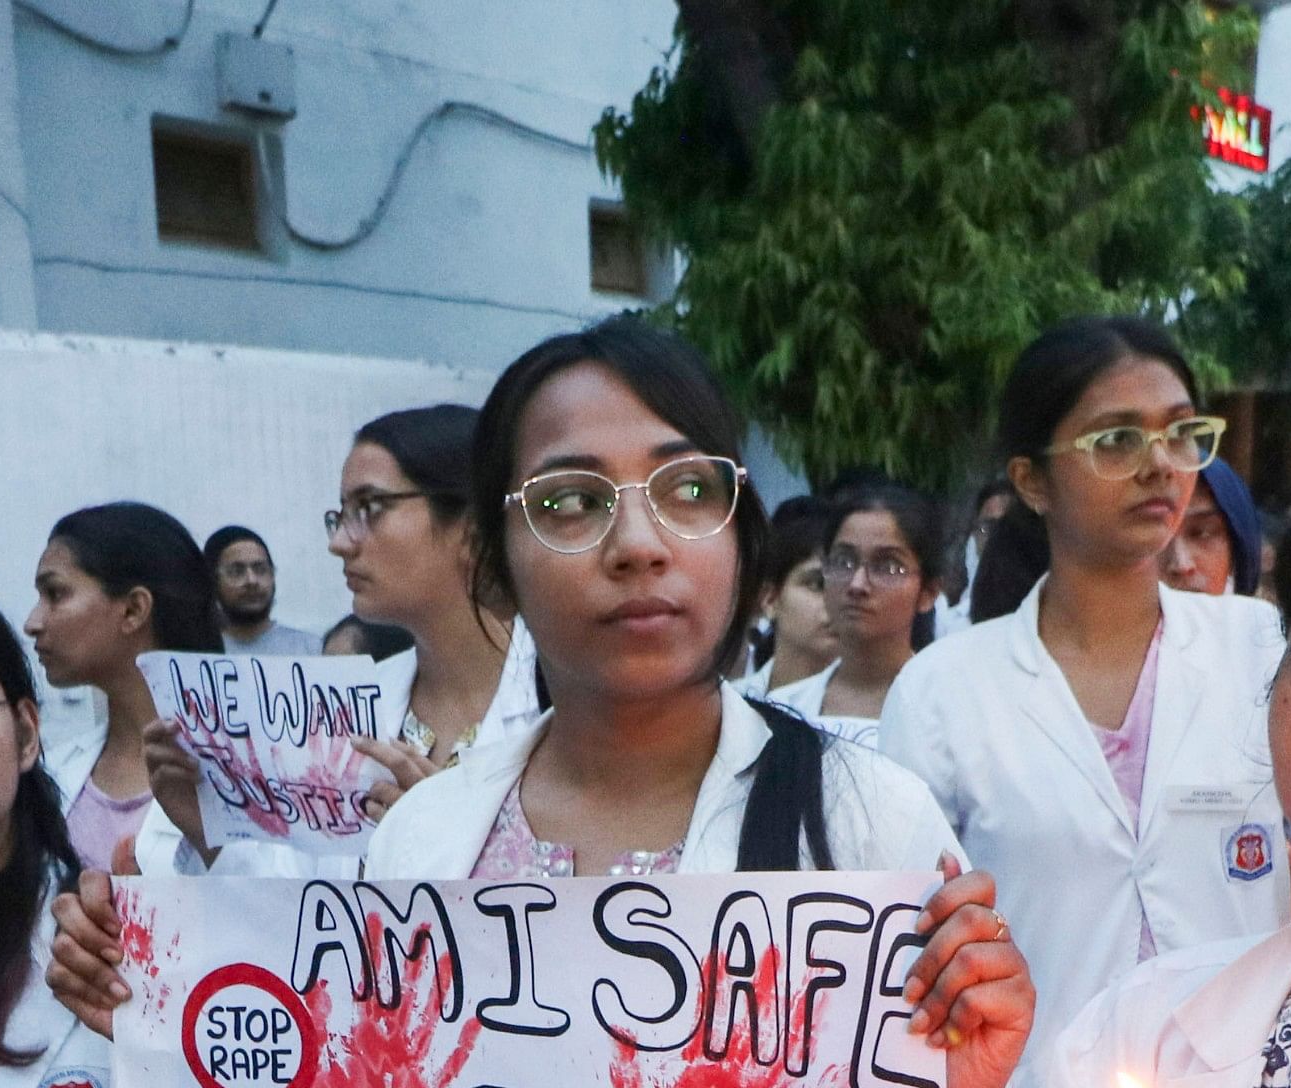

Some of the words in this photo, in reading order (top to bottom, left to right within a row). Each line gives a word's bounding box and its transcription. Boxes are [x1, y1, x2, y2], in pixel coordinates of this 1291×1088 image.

[171, 658, 250, 738] WE
[251, 658, 381, 747] WANT
[291, 880, 463, 1023] AM
[475, 882, 571, 1037] I
[207, 1006, 292, 1044] STOP
[209, 1045, 294, 1083] RAPE
